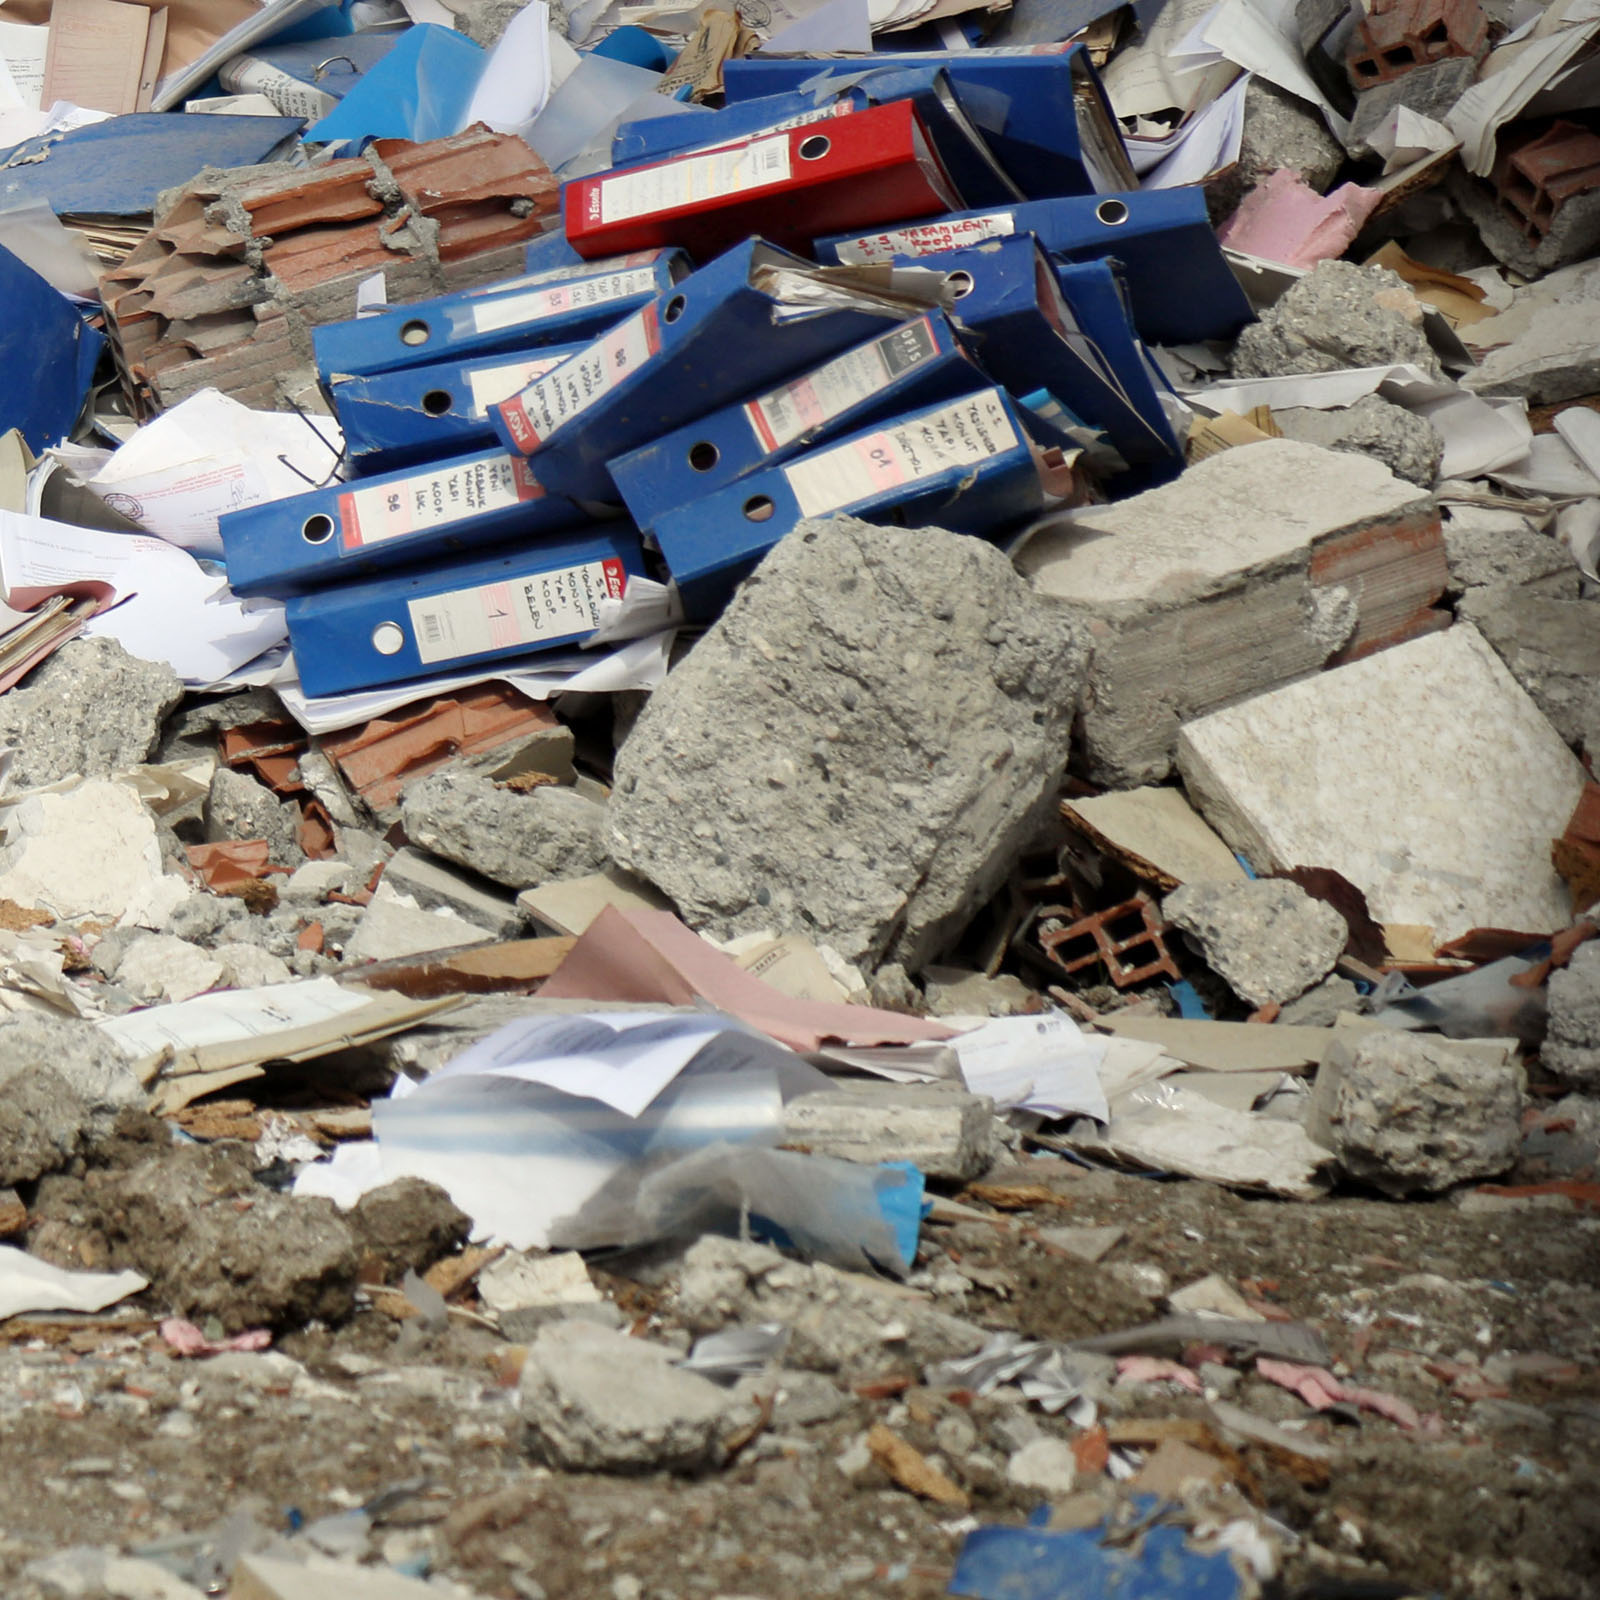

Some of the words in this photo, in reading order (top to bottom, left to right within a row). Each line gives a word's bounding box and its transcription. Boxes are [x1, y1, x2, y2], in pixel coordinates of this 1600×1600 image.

[590, 187, 600, 213] Esselte
[901, 329, 921, 362] OFİS
[552, 376, 566, 415] KONUT
[935, 419, 956, 451] YAPI
[953, 412, 978, 453] KONUT
[869, 448, 893, 469] 01
[448, 474, 459, 503] YAPI
[464, 470, 476, 508] KONUT
[524, 583, 544, 630] BELEN
[555, 575, 567, 610] YAPI
[568, 571, 584, 618] KONUT
